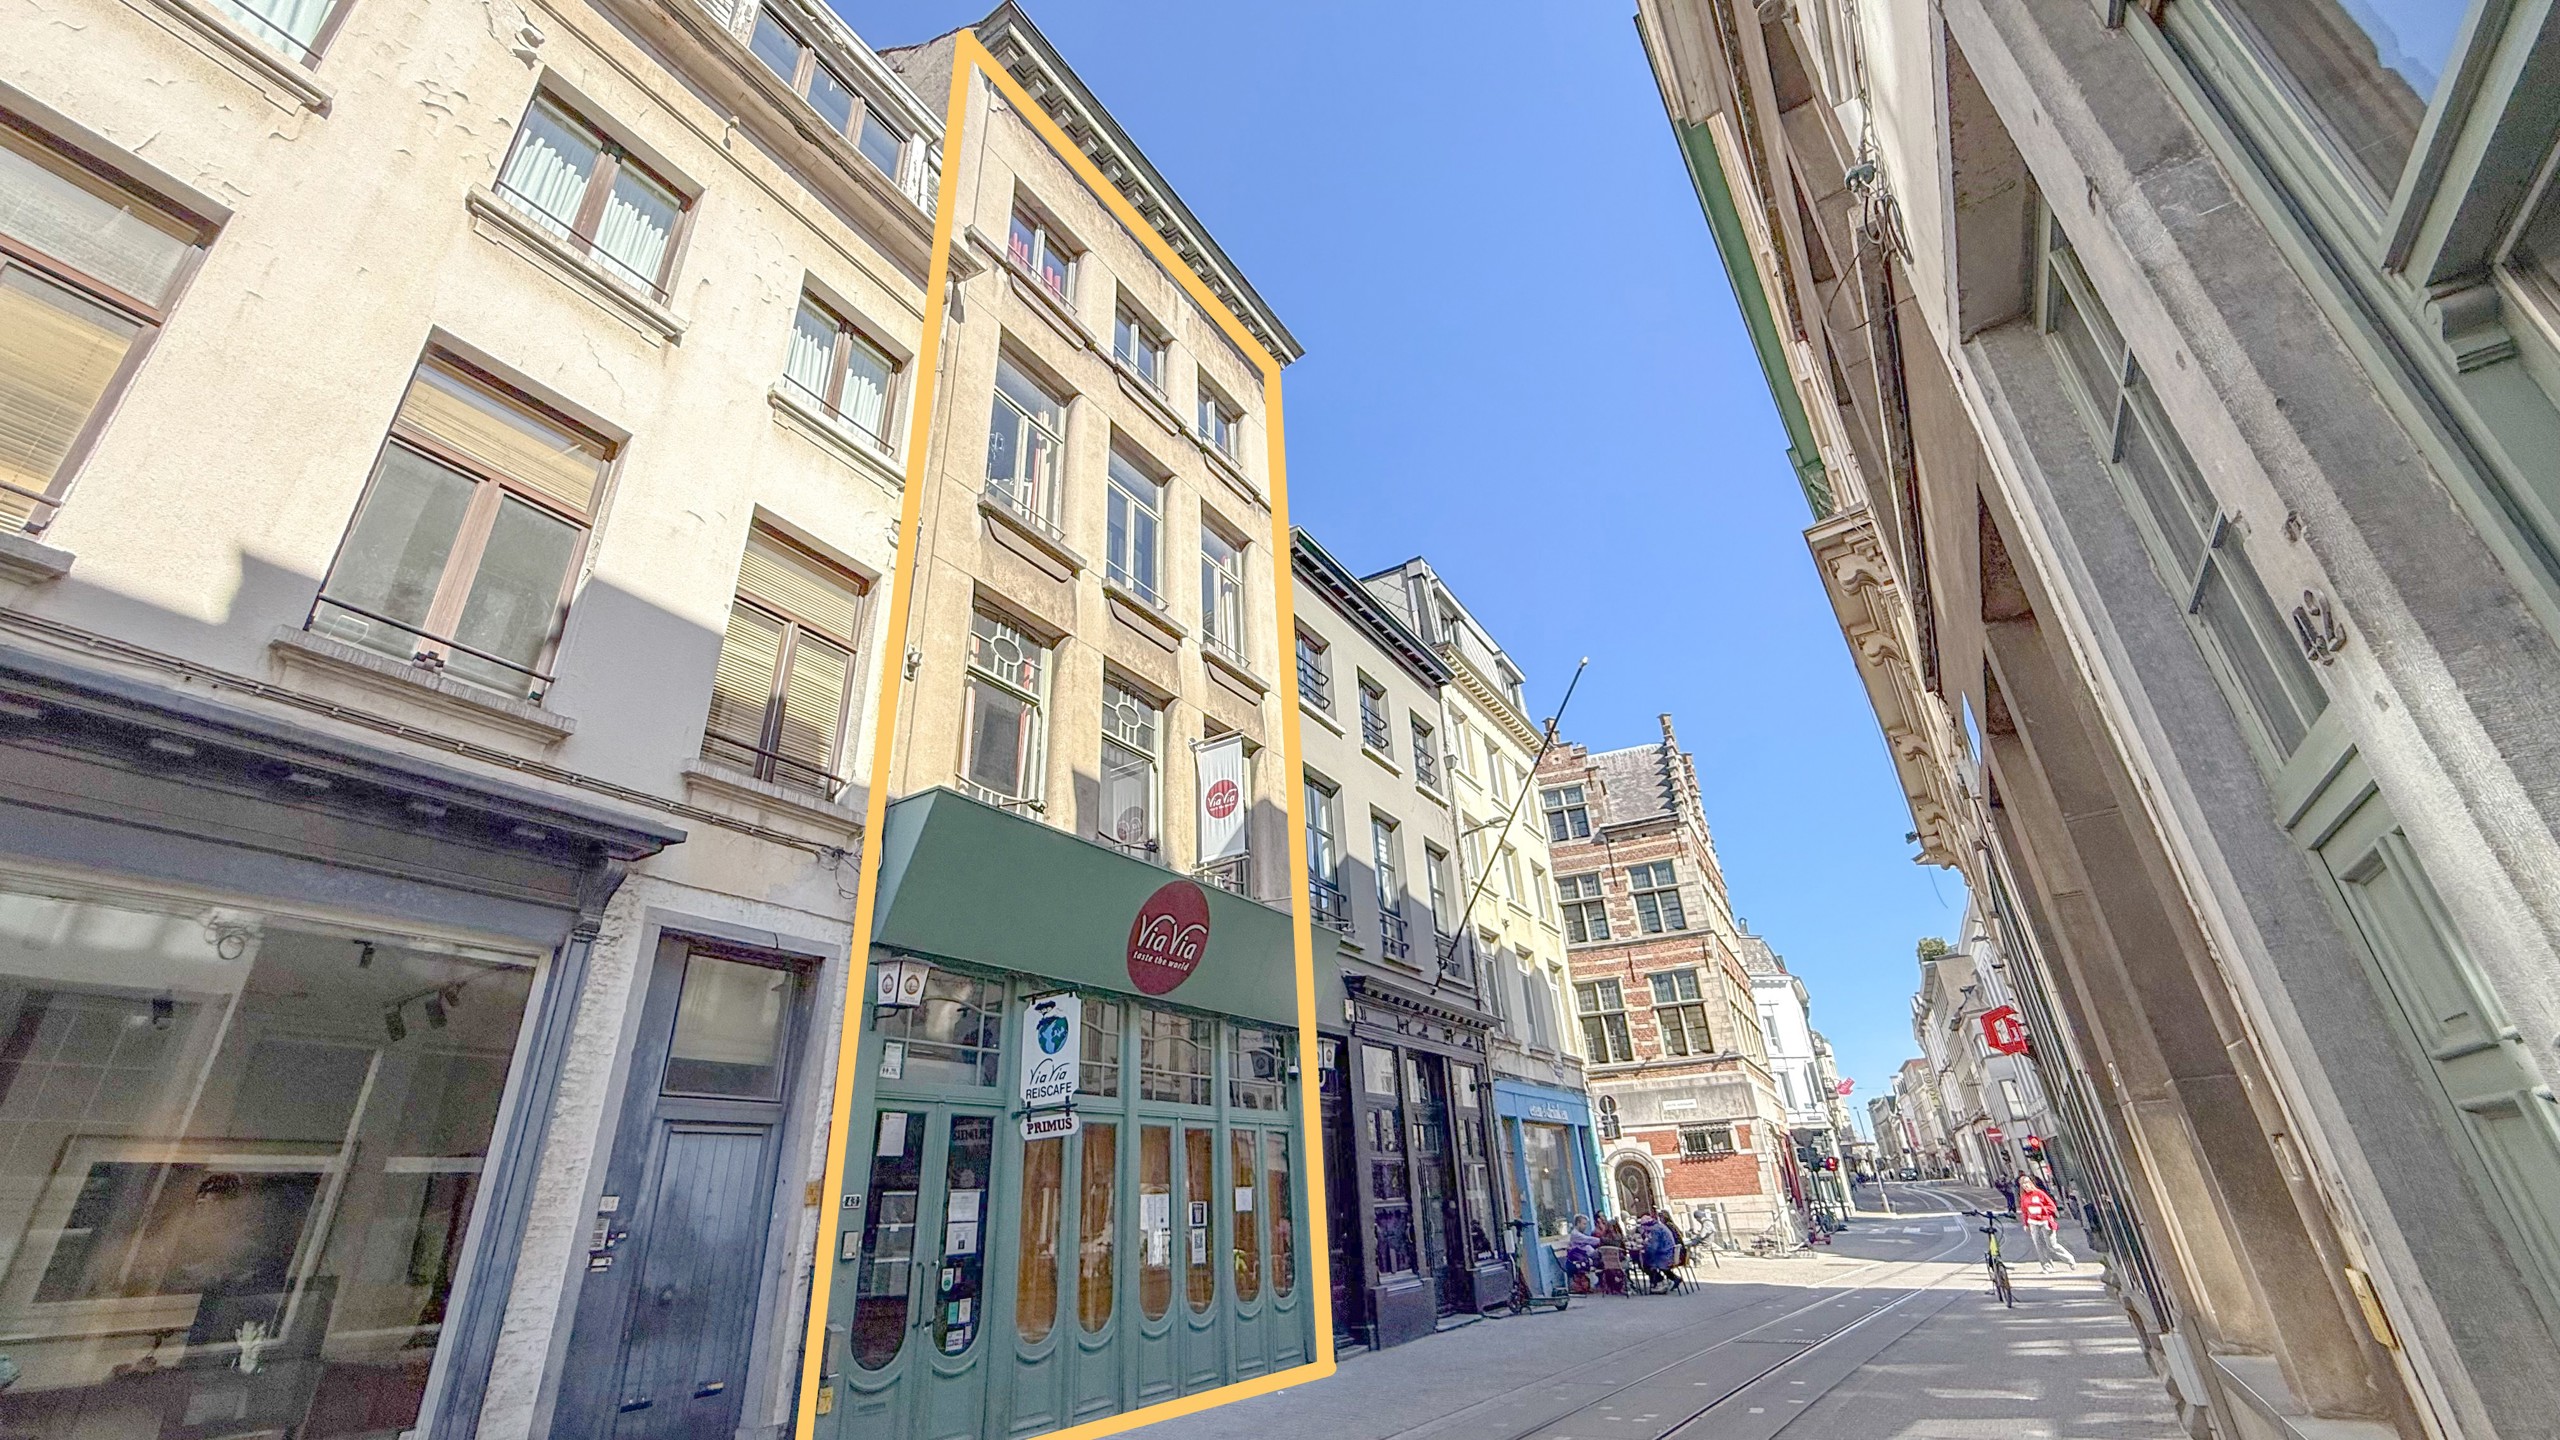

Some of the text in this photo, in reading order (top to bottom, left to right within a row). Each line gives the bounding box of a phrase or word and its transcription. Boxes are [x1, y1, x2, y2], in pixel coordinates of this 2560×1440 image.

[1133, 951, 1190, 971] taste the world
[1026, 1082, 1072, 1099] REISCAFE
[1027, 1118, 1072, 1134] PRIMUS
